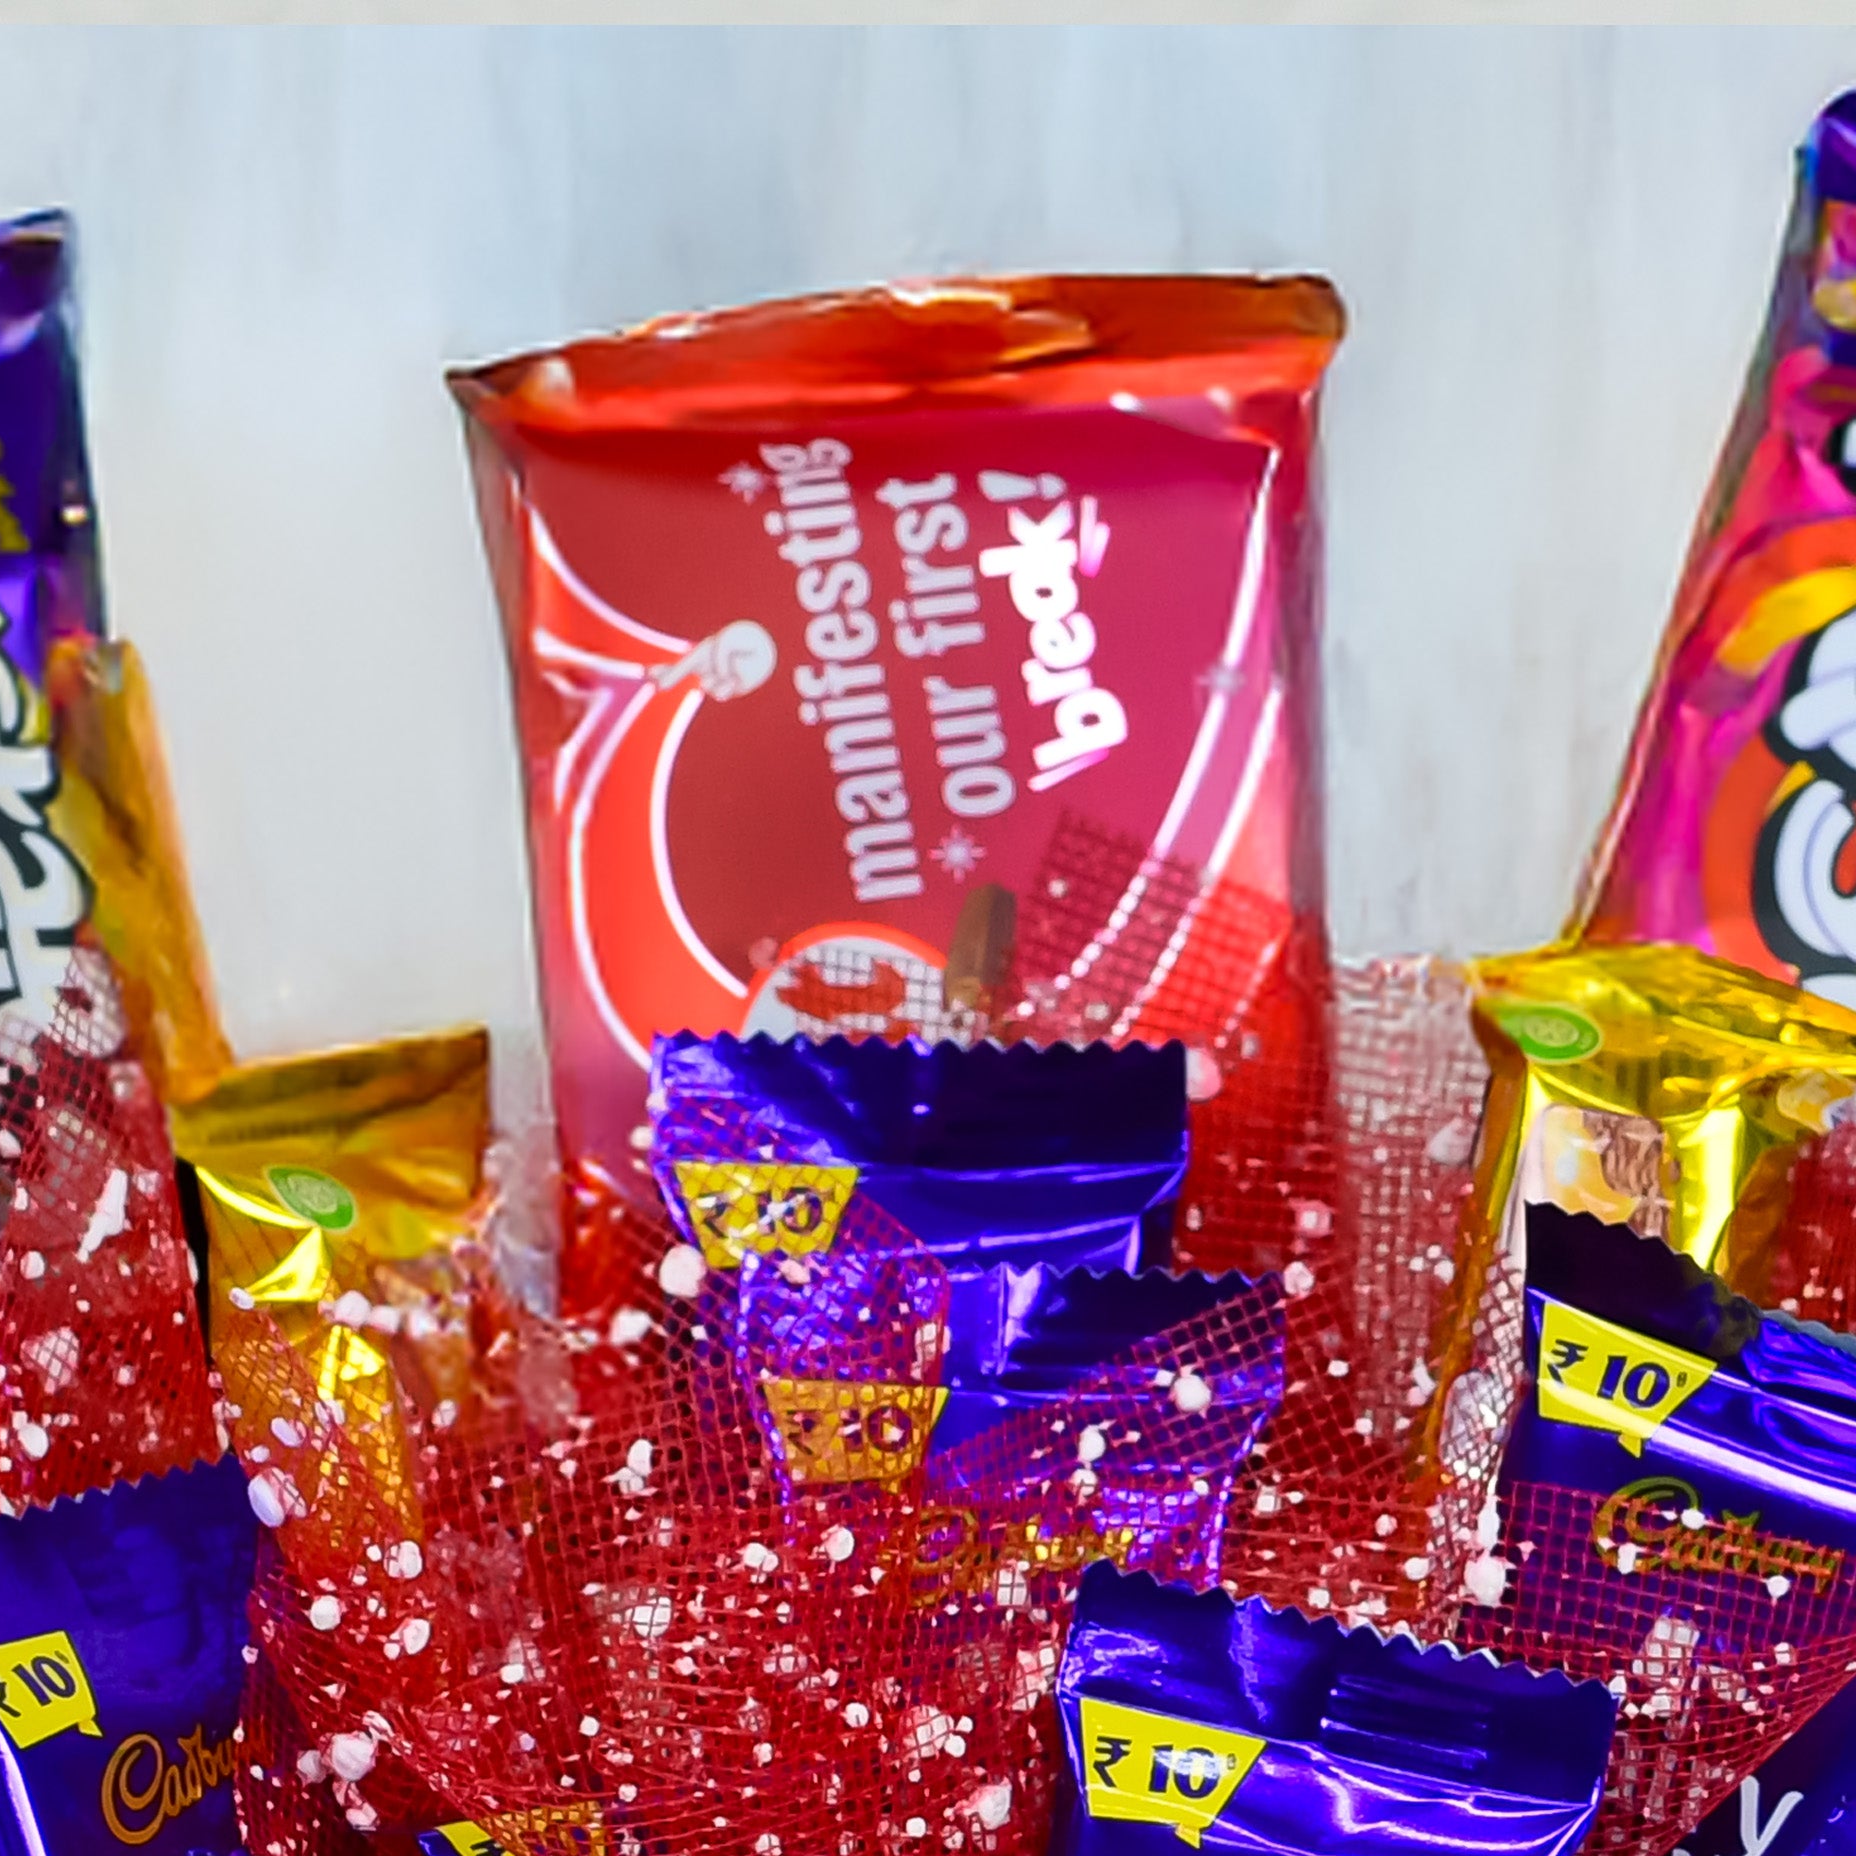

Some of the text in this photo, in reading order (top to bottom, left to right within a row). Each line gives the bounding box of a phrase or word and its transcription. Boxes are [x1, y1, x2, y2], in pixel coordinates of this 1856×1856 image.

[759, 436, 925, 905] manifesting
[876, 471, 1018, 818] our first
[102, 1724, 274, 1845] Cadbu
